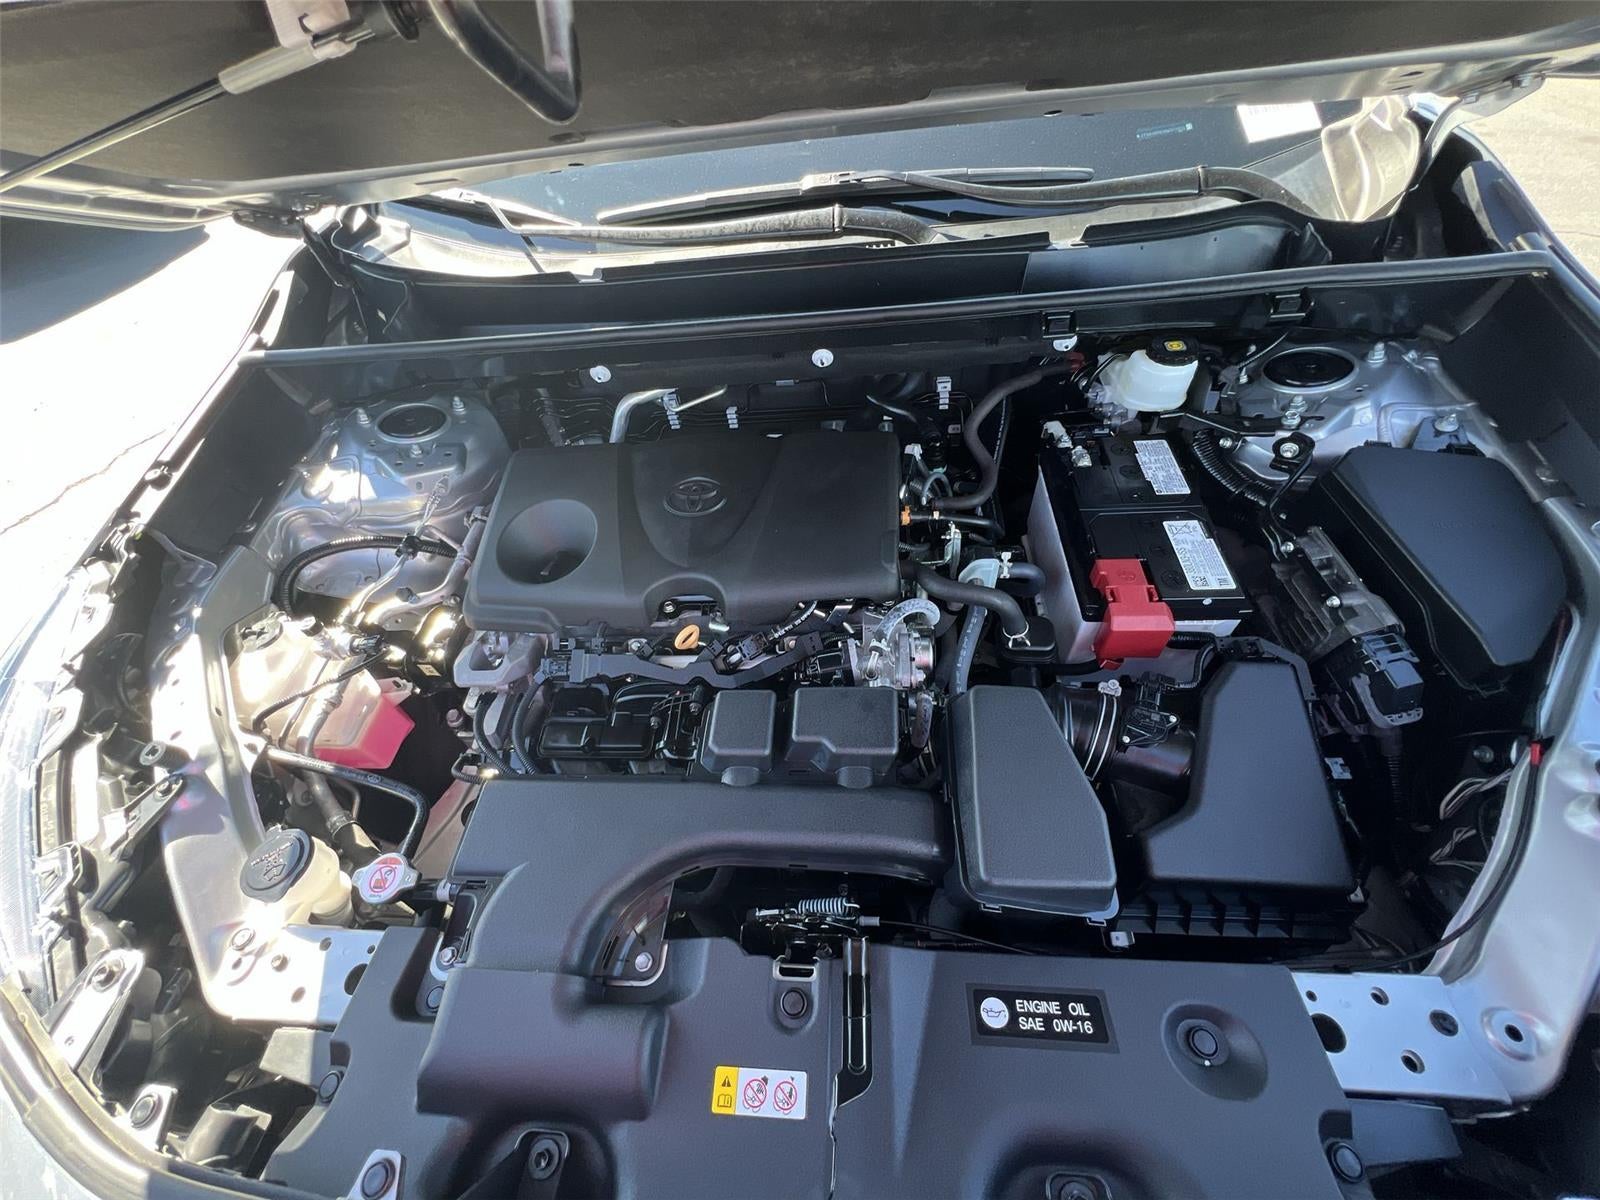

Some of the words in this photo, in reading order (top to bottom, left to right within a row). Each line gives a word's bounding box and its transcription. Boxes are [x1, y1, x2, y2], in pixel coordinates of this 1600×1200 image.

[1015, 999, 1061, 1014] ENGINE
[1068, 1003, 1090, 1016] OIL
[1019, 1017, 1045, 1031] SAE
[1053, 1019, 1093, 1034] 0W-16
